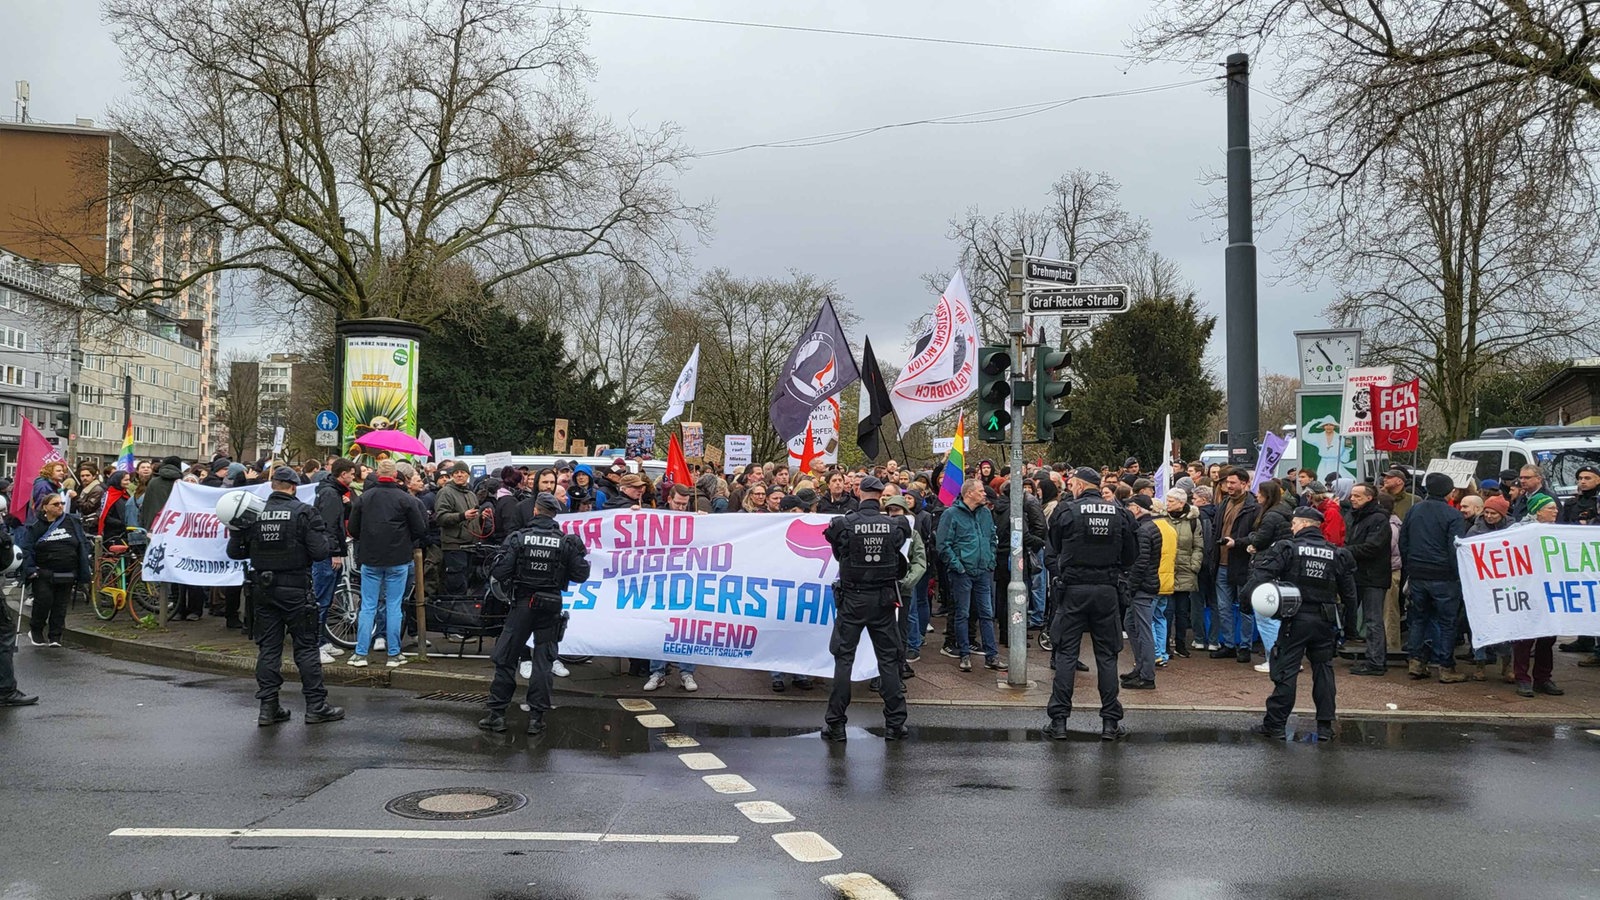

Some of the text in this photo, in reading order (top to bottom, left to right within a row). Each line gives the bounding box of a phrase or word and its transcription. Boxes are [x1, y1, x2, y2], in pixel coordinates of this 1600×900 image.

[1032, 264, 1073, 281] Brehmplatz
[1032, 293, 1119, 309] Graf-Recke-Straße
[908, 346, 938, 373] AKTION
[1349, 375, 1387, 383] WIDERSTAND
[1380, 387, 1416, 409] FCK
[1380, 406, 1418, 431] AFD
[1080, 504, 1116, 514] POLIZEI
[256, 511, 291, 521] POLIZEI
[1088, 517, 1109, 526] NRW
[175, 512, 221, 539] WIEDER
[260, 523, 281, 532] NRW
[613, 513, 694, 549] SIND
[854, 523, 890, 534] POLIZEI
[1091, 527, 1108, 535] 1222
[262, 533, 280, 541] 1222
[524, 535, 560, 548] POLIZEI
[863, 537, 884, 546] NRW
[529, 549, 551, 558] NRW
[864, 545, 882, 553] 1222
[1298, 546, 1334, 560] POLIZEI
[175, 556, 230, 574] DÜSSELDORF
[530, 561, 548, 571] 1223
[603, 542, 733, 579] JUGEND
[1305, 560, 1326, 570] NRW
[1305, 568, 1324, 578] 1222
[1492, 580, 1600, 614] FÜR HET
[665, 617, 758, 650] JUGEND
